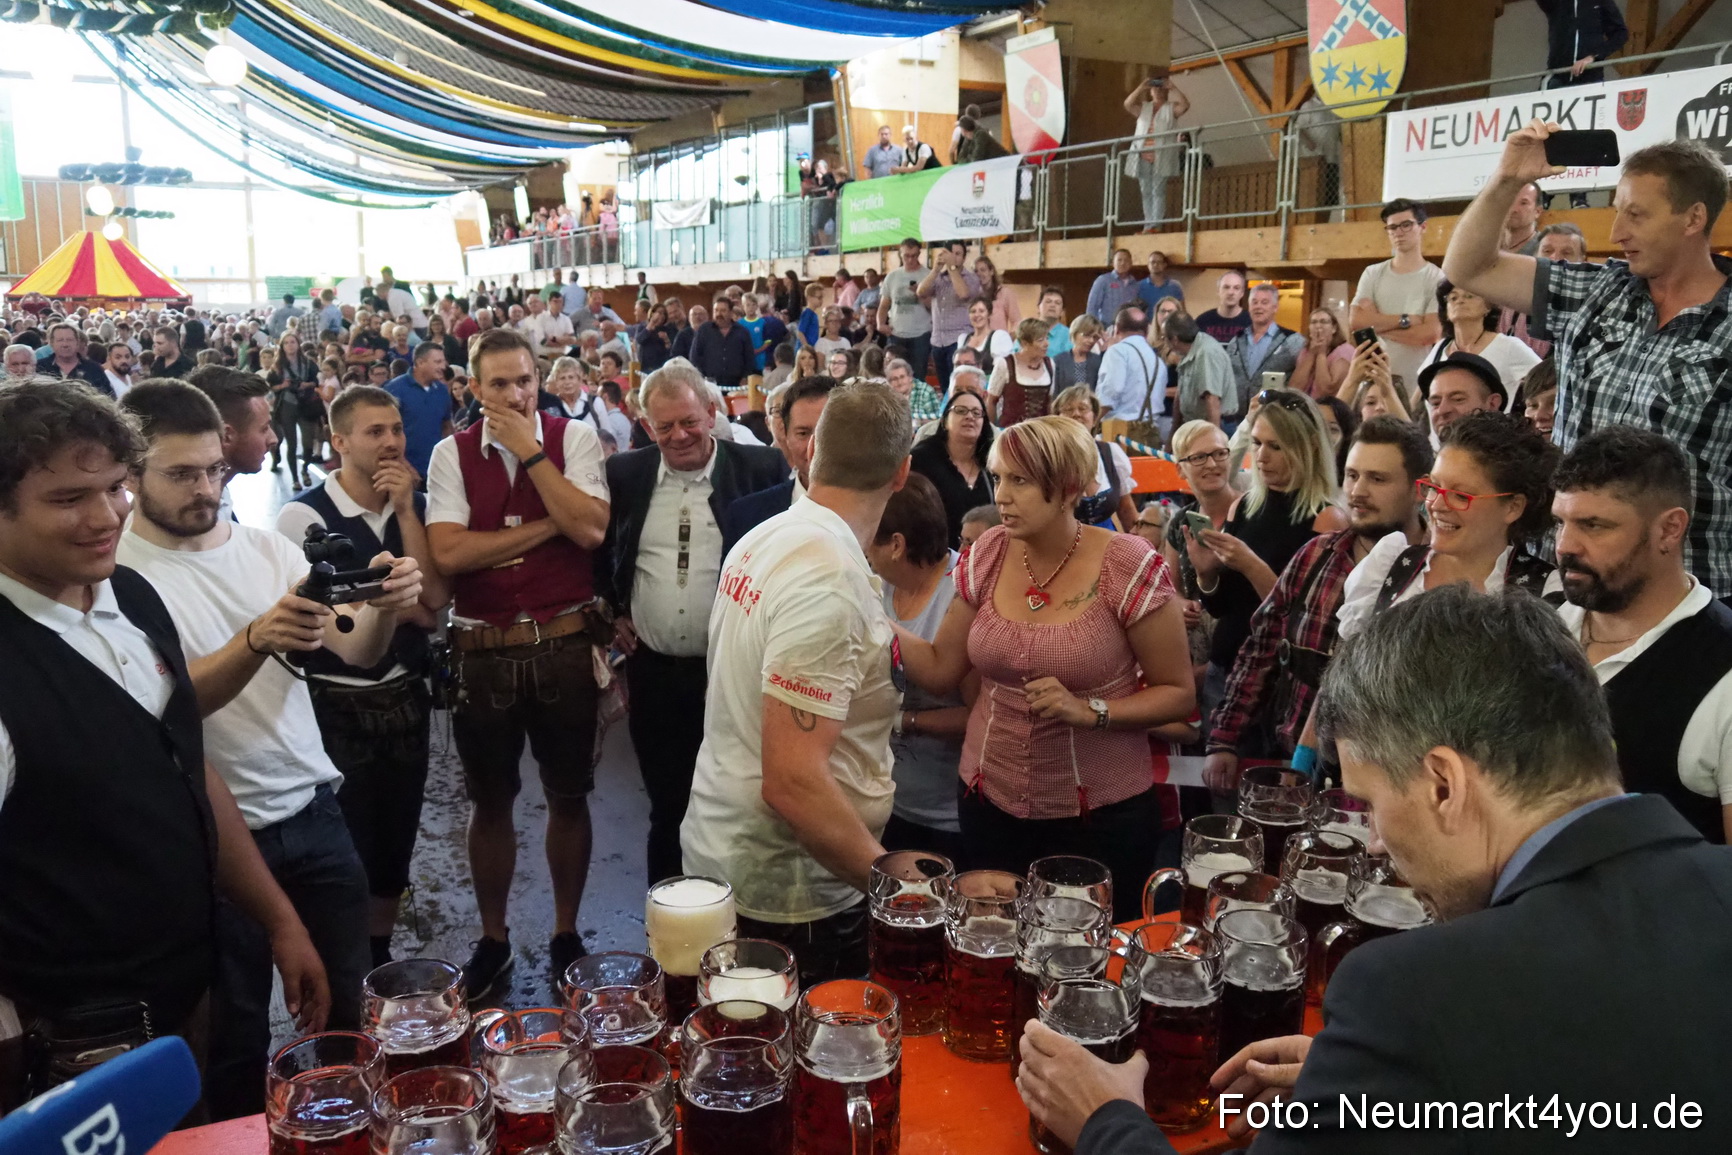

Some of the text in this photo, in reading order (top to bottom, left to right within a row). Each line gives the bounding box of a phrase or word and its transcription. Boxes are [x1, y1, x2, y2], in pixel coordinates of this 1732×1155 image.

[1406, 94, 1606, 152] NEUMARKT
[849, 193, 884, 212] Herzlich
[850, 217, 901, 235] Willkommen
[769, 673, 832, 702] Schönblick
